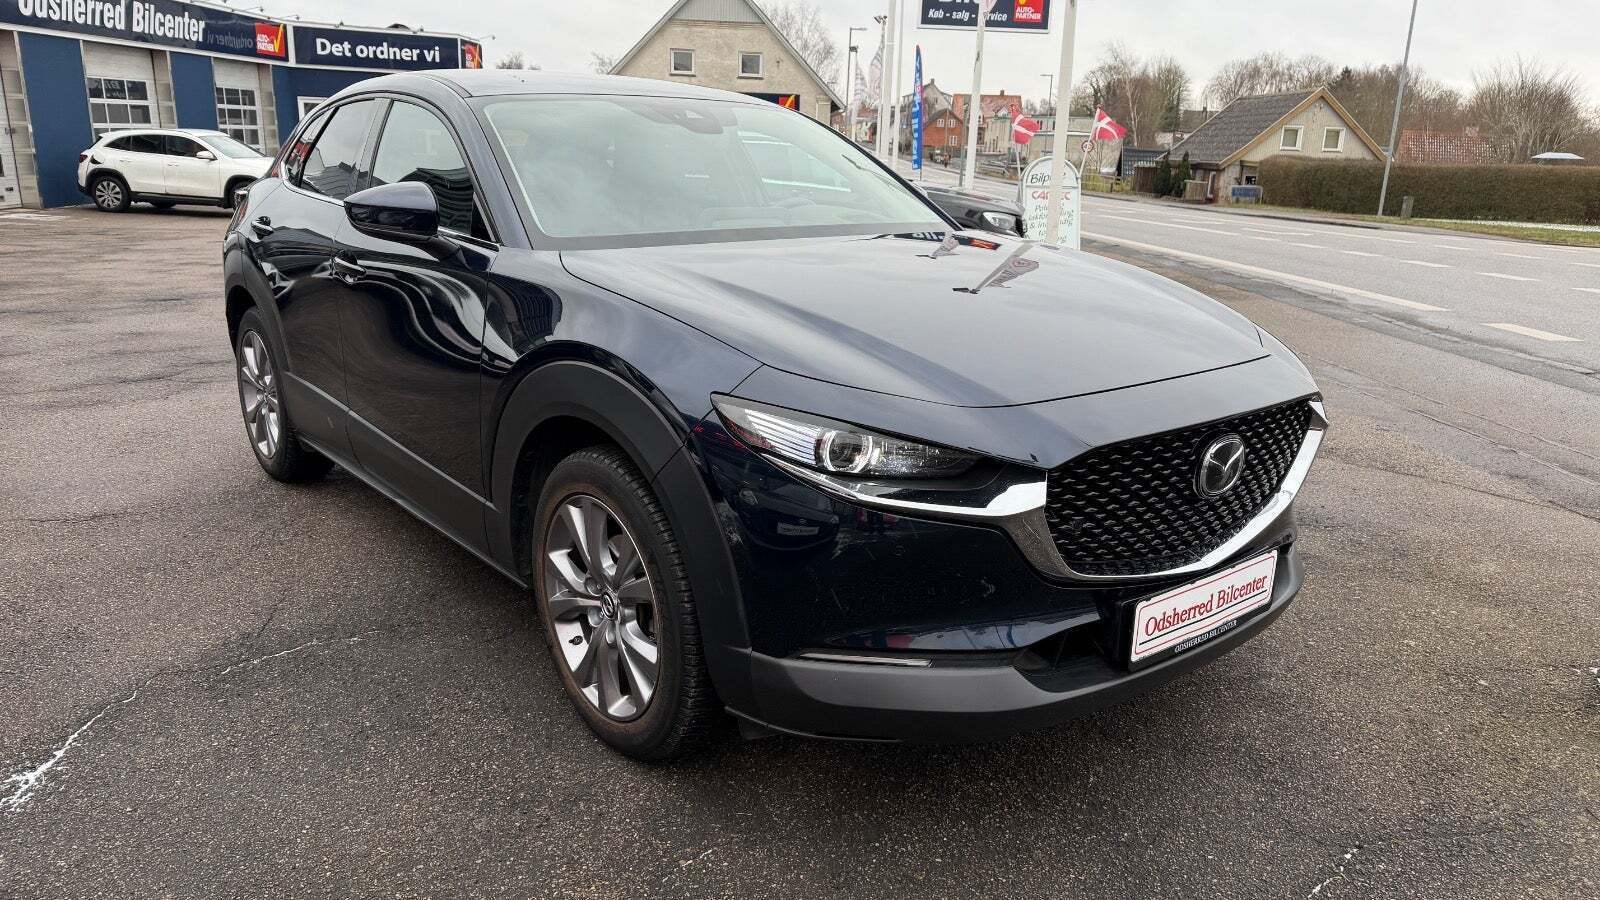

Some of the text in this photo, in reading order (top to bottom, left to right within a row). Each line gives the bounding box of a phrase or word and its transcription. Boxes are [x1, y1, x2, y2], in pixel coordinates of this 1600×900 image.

[132, 1, 206, 42] Bilcenter
[928, 8, 945, 19] Køb
[952, 11, 970, 22] salg
[1015, 12, 1042, 20] PARTNER
[315, 38, 441, 63] Det ordner vi
[1145, 575, 1268, 636] Odsherred Bilcenter
[1174, 633, 1209, 653] ODSHERRED
